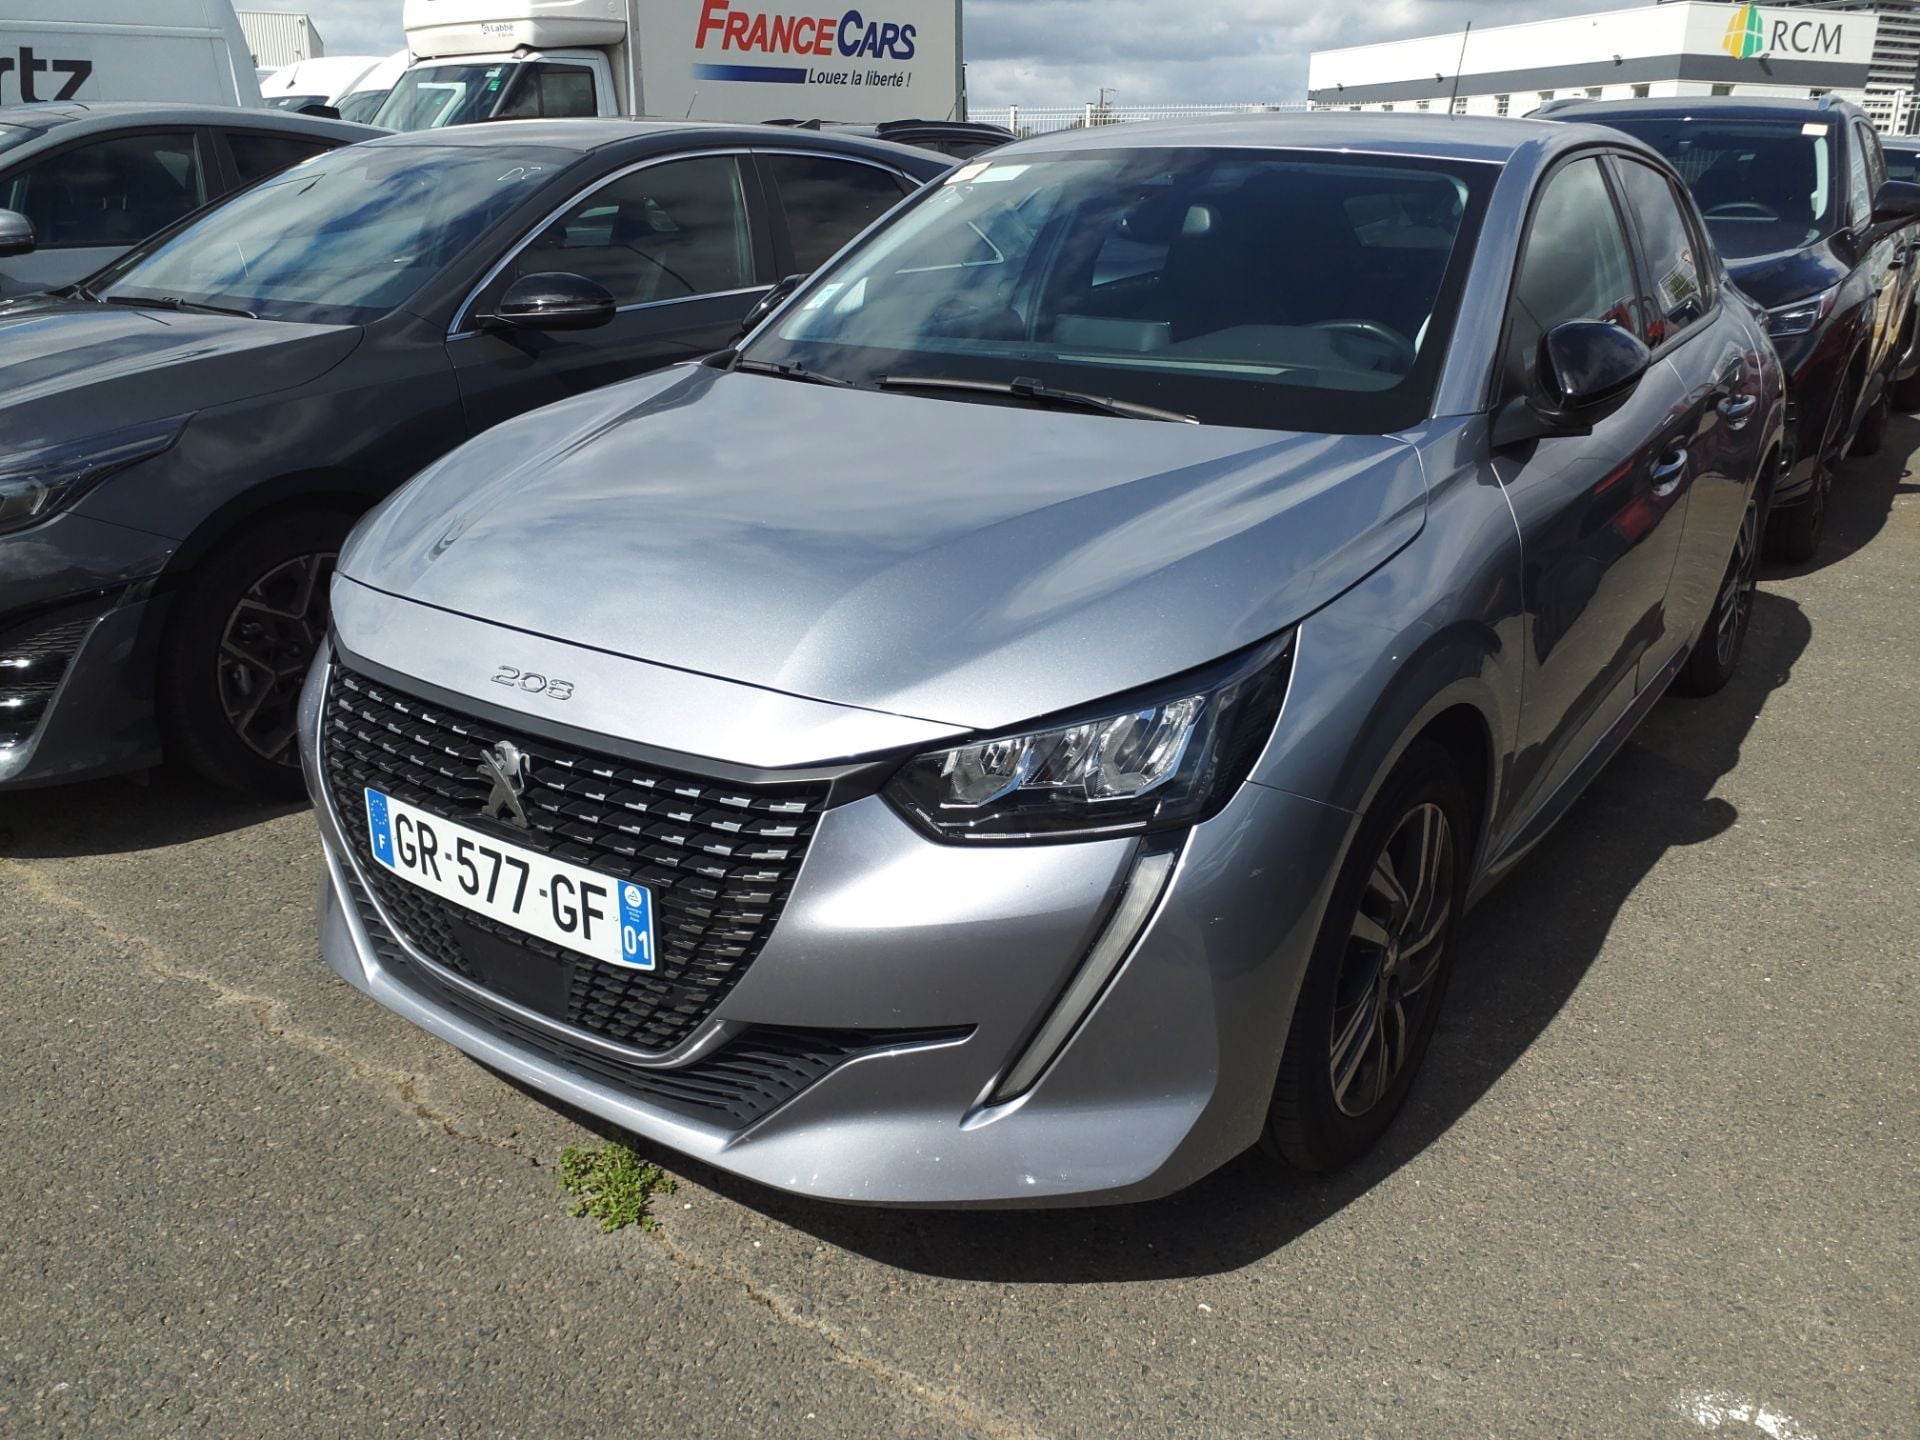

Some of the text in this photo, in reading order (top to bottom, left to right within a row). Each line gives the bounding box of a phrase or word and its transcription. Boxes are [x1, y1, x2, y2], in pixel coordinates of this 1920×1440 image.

[1769, 20, 1843, 55] RCM
[808, 68, 848, 85] Louez
[850, 69, 862, 85] la
[865, 70, 904, 88] liberté
[490, 665, 575, 700] 208
[378, 833, 386, 850] F
[395, 813, 607, 940] GR-577-GF
[624, 925, 649, 960] 01
